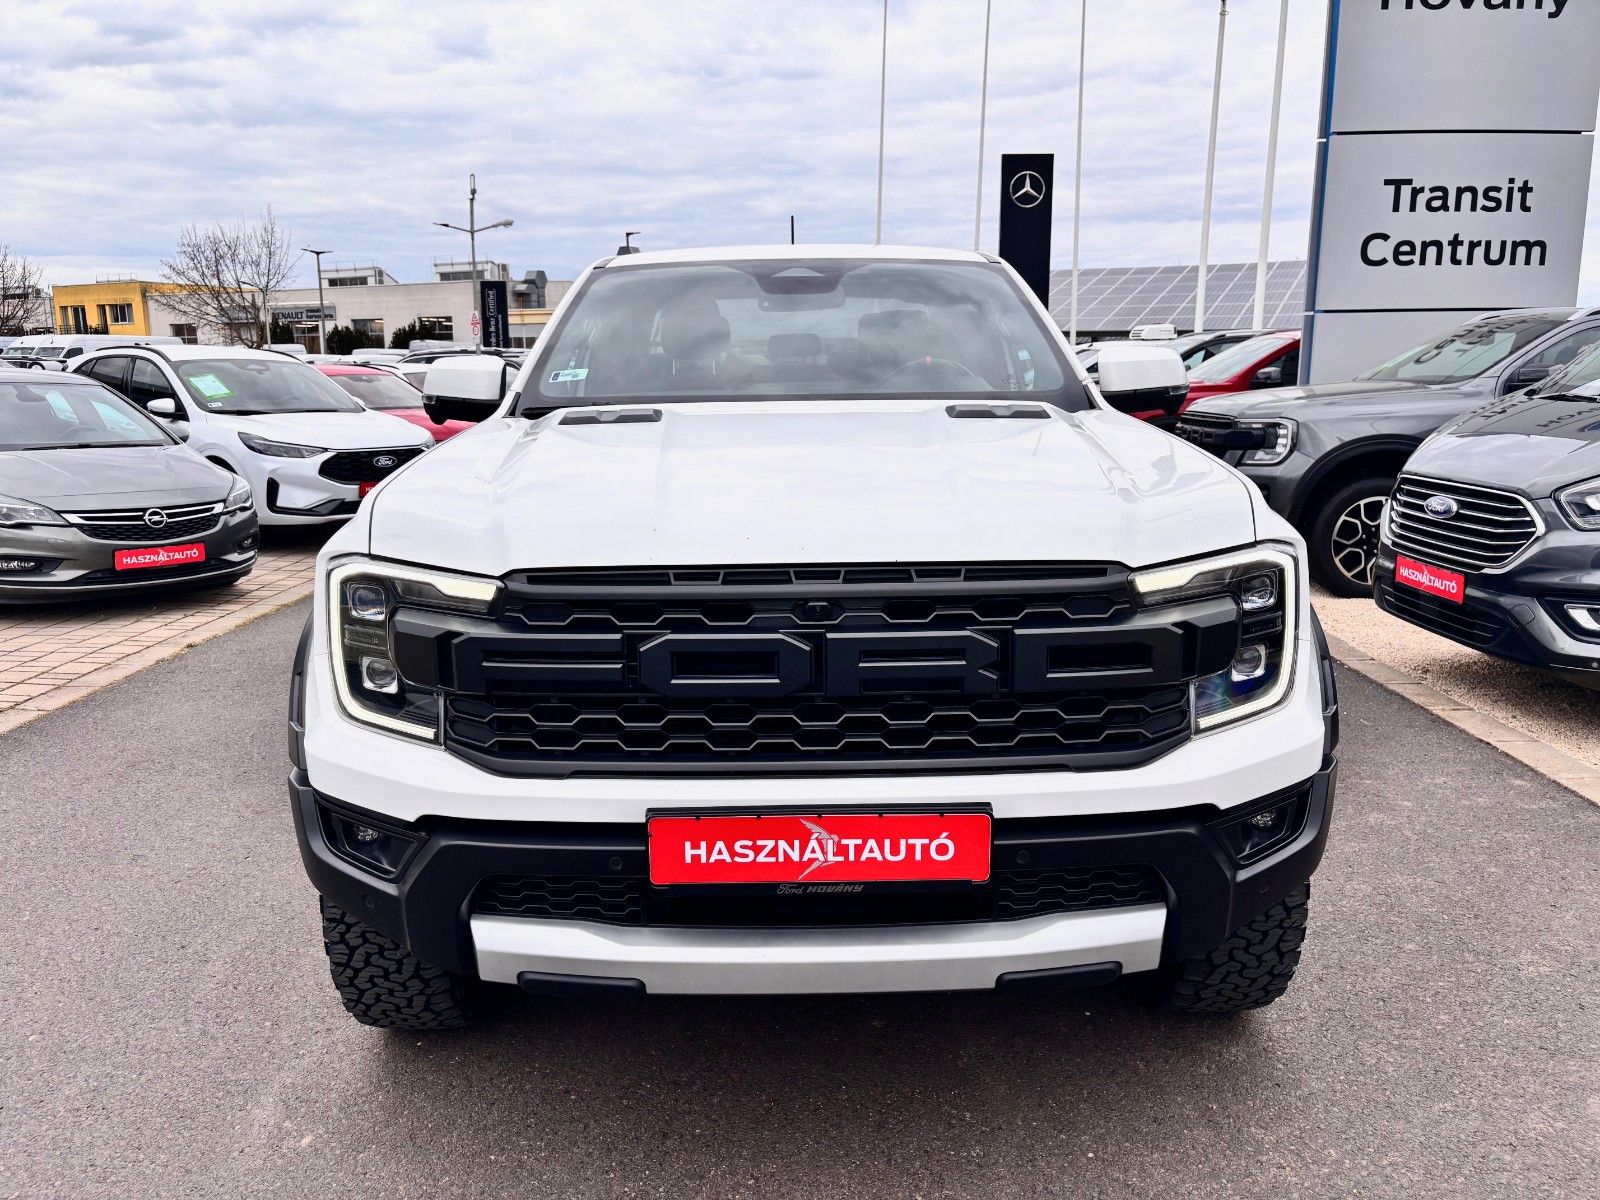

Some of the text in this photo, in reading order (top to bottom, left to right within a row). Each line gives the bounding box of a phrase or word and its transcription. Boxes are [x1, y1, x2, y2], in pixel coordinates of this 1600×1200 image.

[1383, 178, 1533, 213] Transit
[1360, 232, 1547, 267] Centrum
[377, 457, 393, 466] Ford
[122, 547, 199, 565] HASZNÁLTAUTÓ
[1400, 566, 1458, 594] HASZNÁLTAUTÓ
[450, 626, 1184, 698] FORD
[684, 832, 955, 864] HASZNÁLTAUTÓ
[777, 883, 804, 895] Ford
